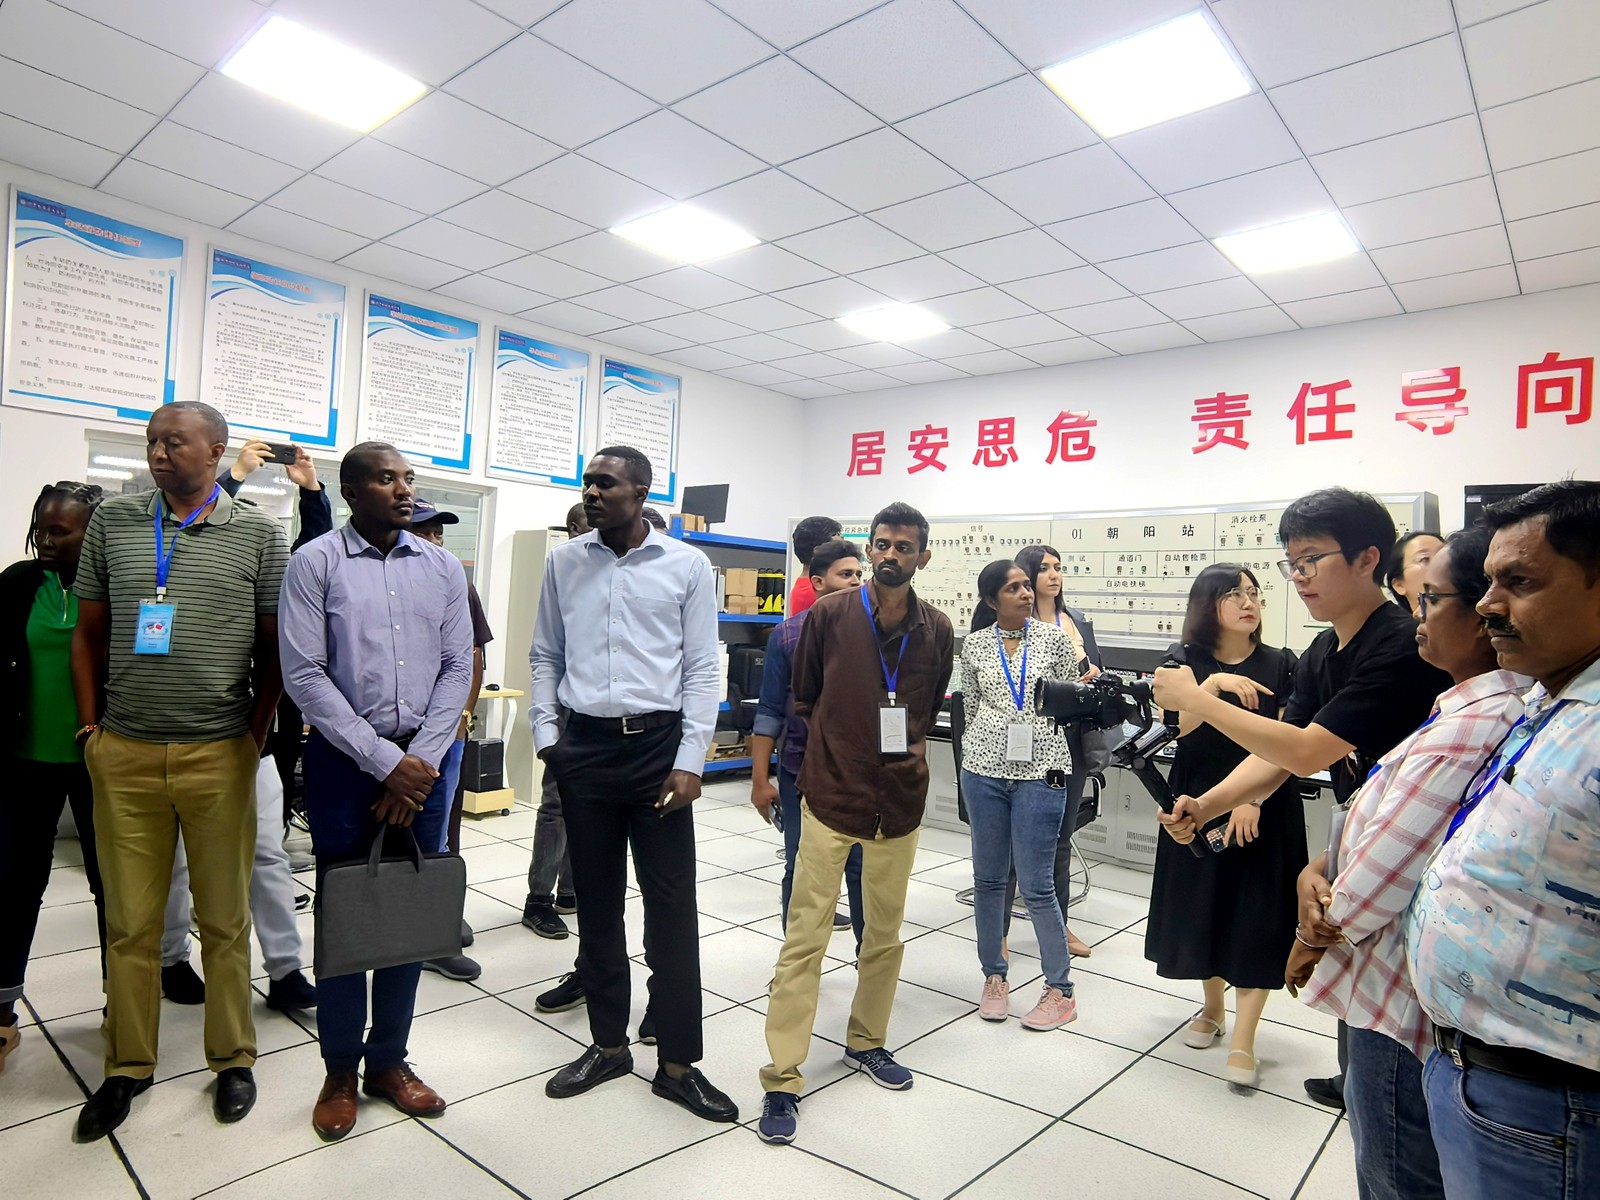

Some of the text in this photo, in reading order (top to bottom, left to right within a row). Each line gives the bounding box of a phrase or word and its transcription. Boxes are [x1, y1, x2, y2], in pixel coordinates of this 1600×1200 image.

[847, 351, 1593, 477] 居安思危 责任导向
[1231, 514, 1267, 525] 消火栓泵
[1071, 524, 1195, 539] 01 朝阳站
[1067, 554, 1086, 563] 测试
[1118, 554, 1142, 563] 通道门
[1164, 552, 1207, 562] 自动售检票
[1241, 561, 1270, 570] 防电源
[1106, 579, 1146, 588] 自动电扶梯
